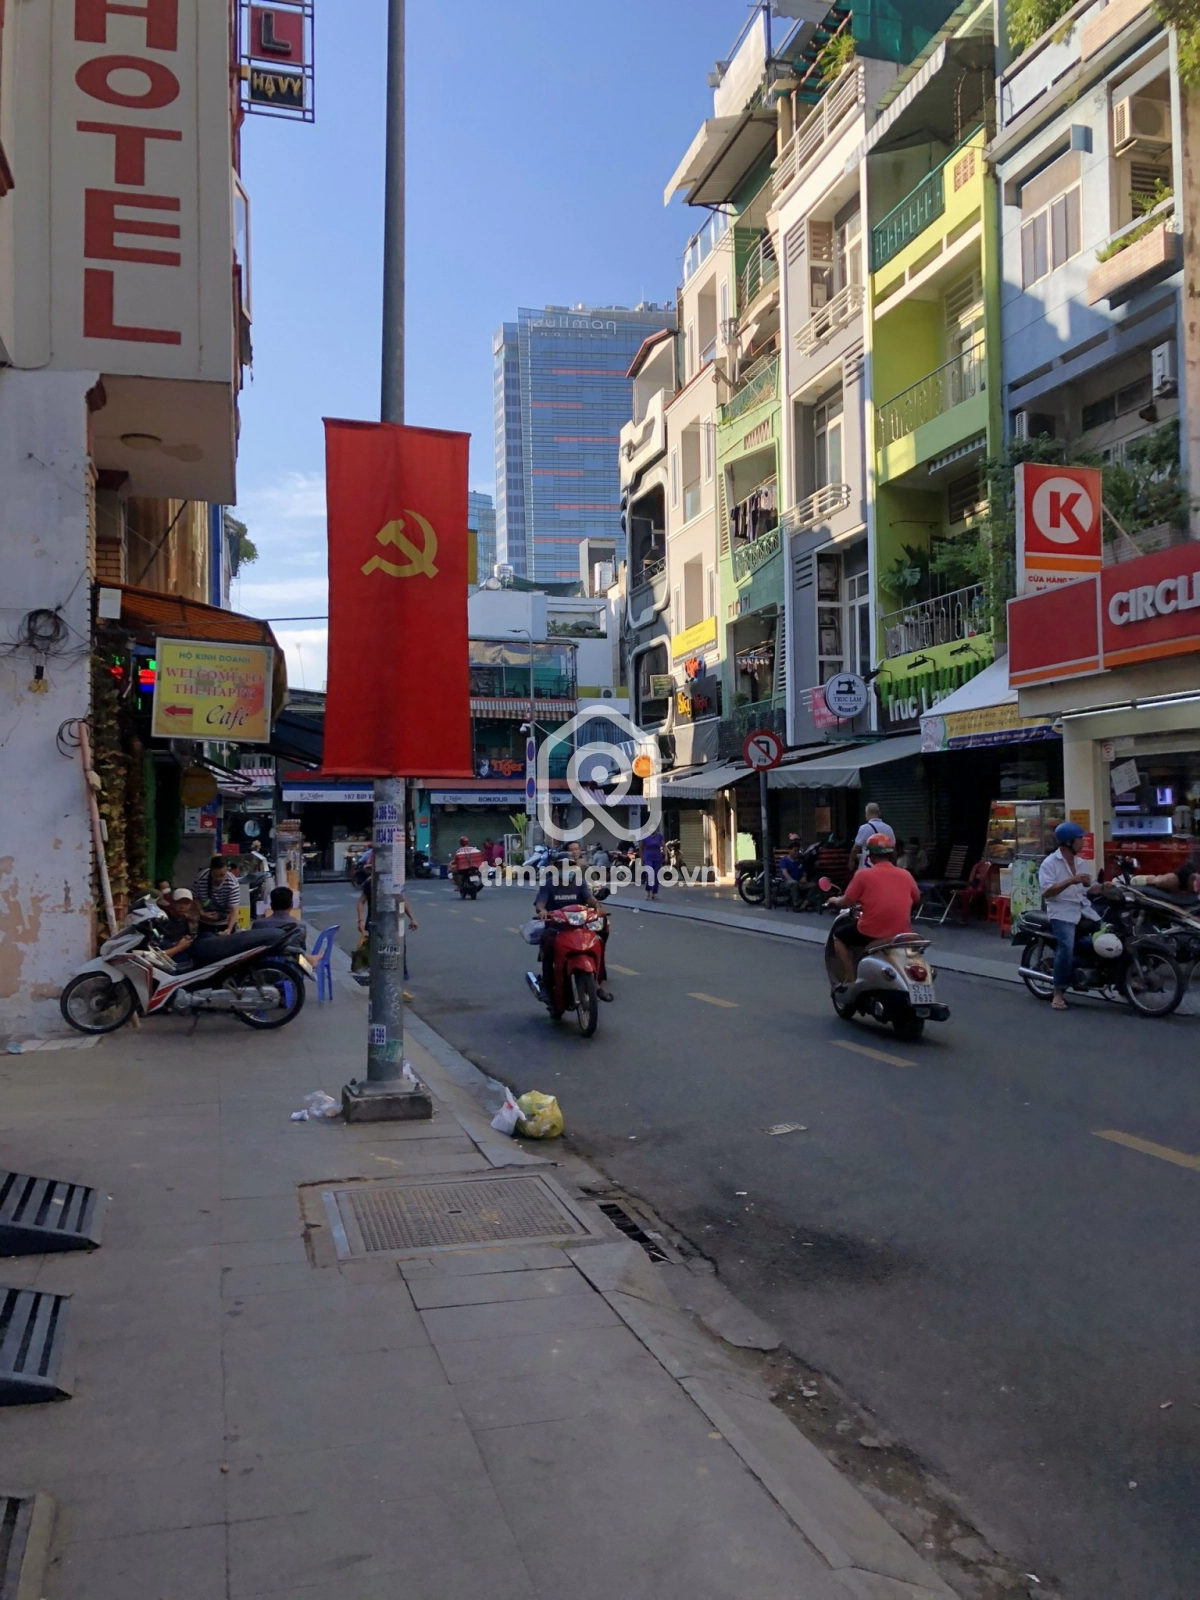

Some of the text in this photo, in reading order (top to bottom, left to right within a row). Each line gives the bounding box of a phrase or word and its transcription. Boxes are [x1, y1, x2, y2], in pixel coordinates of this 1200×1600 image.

[74, 0, 182, 345] HOTEL
[530, 315, 617, 335] pullman
[195, 653, 217, 661] KINH
[219, 655, 251, 663] DOANH
[165, 667, 236, 682] WELCOME
[173, 684, 256, 700] THE HAPPY
[206, 704, 250, 731] Café
[491, 759, 525, 777] Tiger
[913, 993, 933, 1003] 7632
